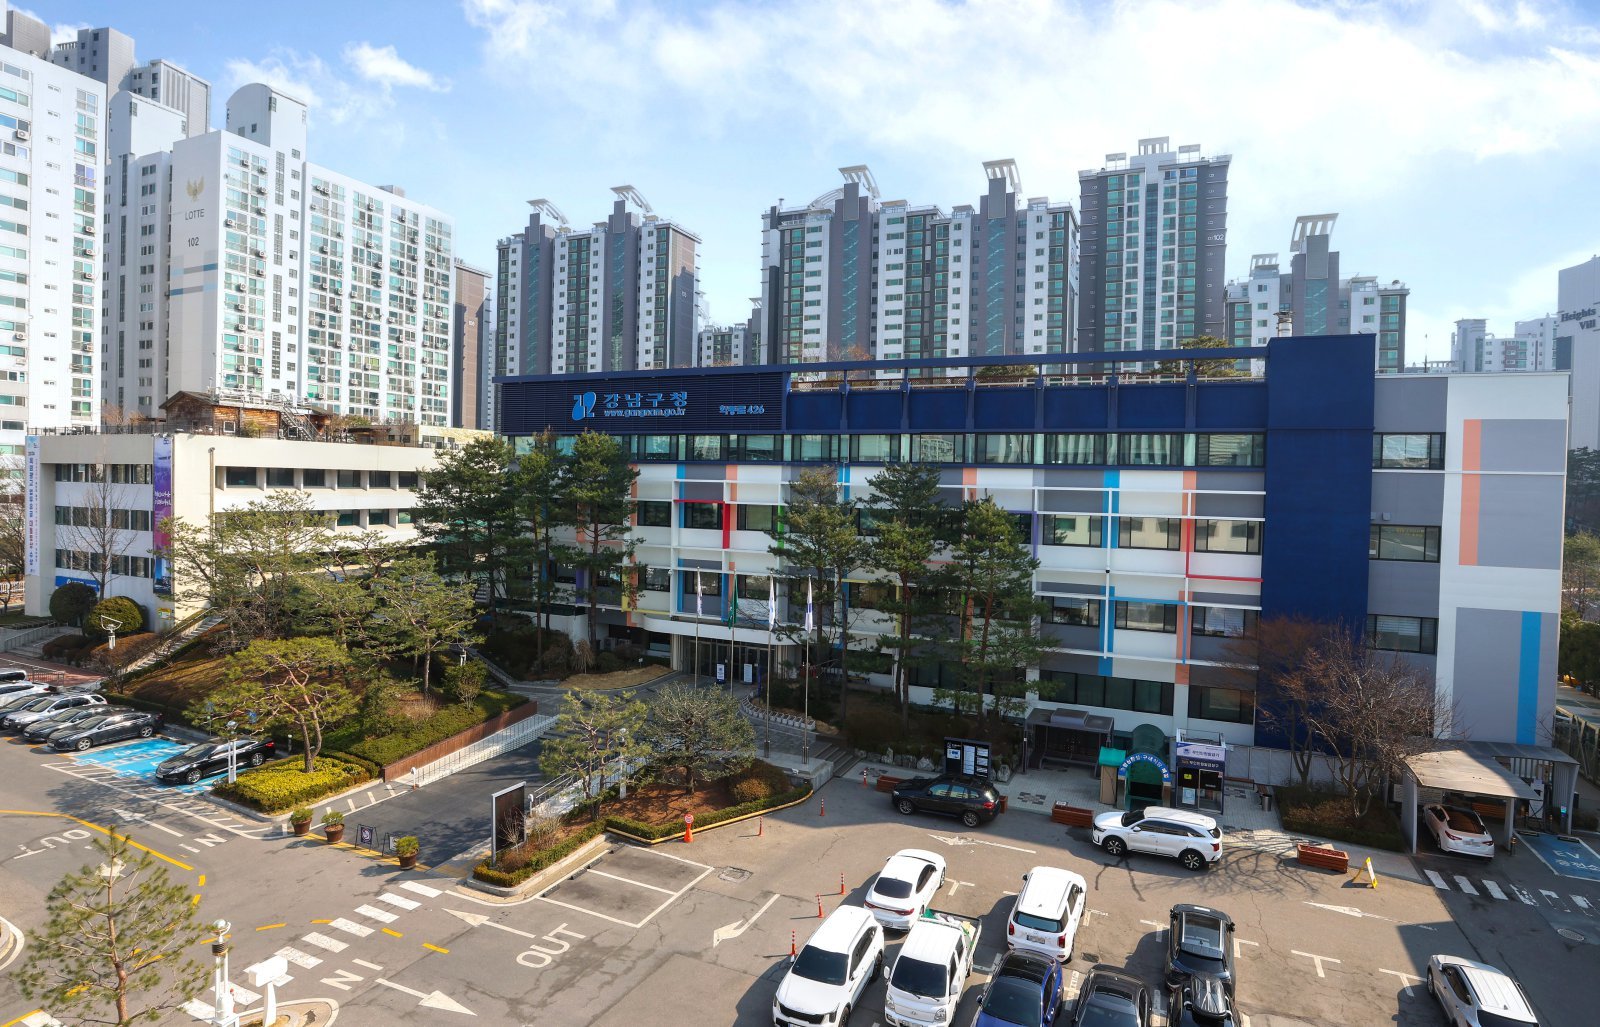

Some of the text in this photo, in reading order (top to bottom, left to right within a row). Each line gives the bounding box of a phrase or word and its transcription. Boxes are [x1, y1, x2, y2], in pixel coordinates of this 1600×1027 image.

[184, 208, 205, 221] LOTTE
[187, 236, 200, 248] 102
[1213, 233, 1225, 241] 102
[1560, 308, 1597, 323] Heights
[1579, 319, 1597, 330] Vill
[603, 391, 688, 408] 강남구청
[603, 407, 686, 418] www.gangnam.go.kr
[747, 404, 765, 415] 426
[13, 829, 92, 860] OUT
[178, 833, 228, 853] IN
[1552, 850, 1579, 859] EV
[516, 922, 587, 968] OUT
[319, 958, 384, 991] IN
